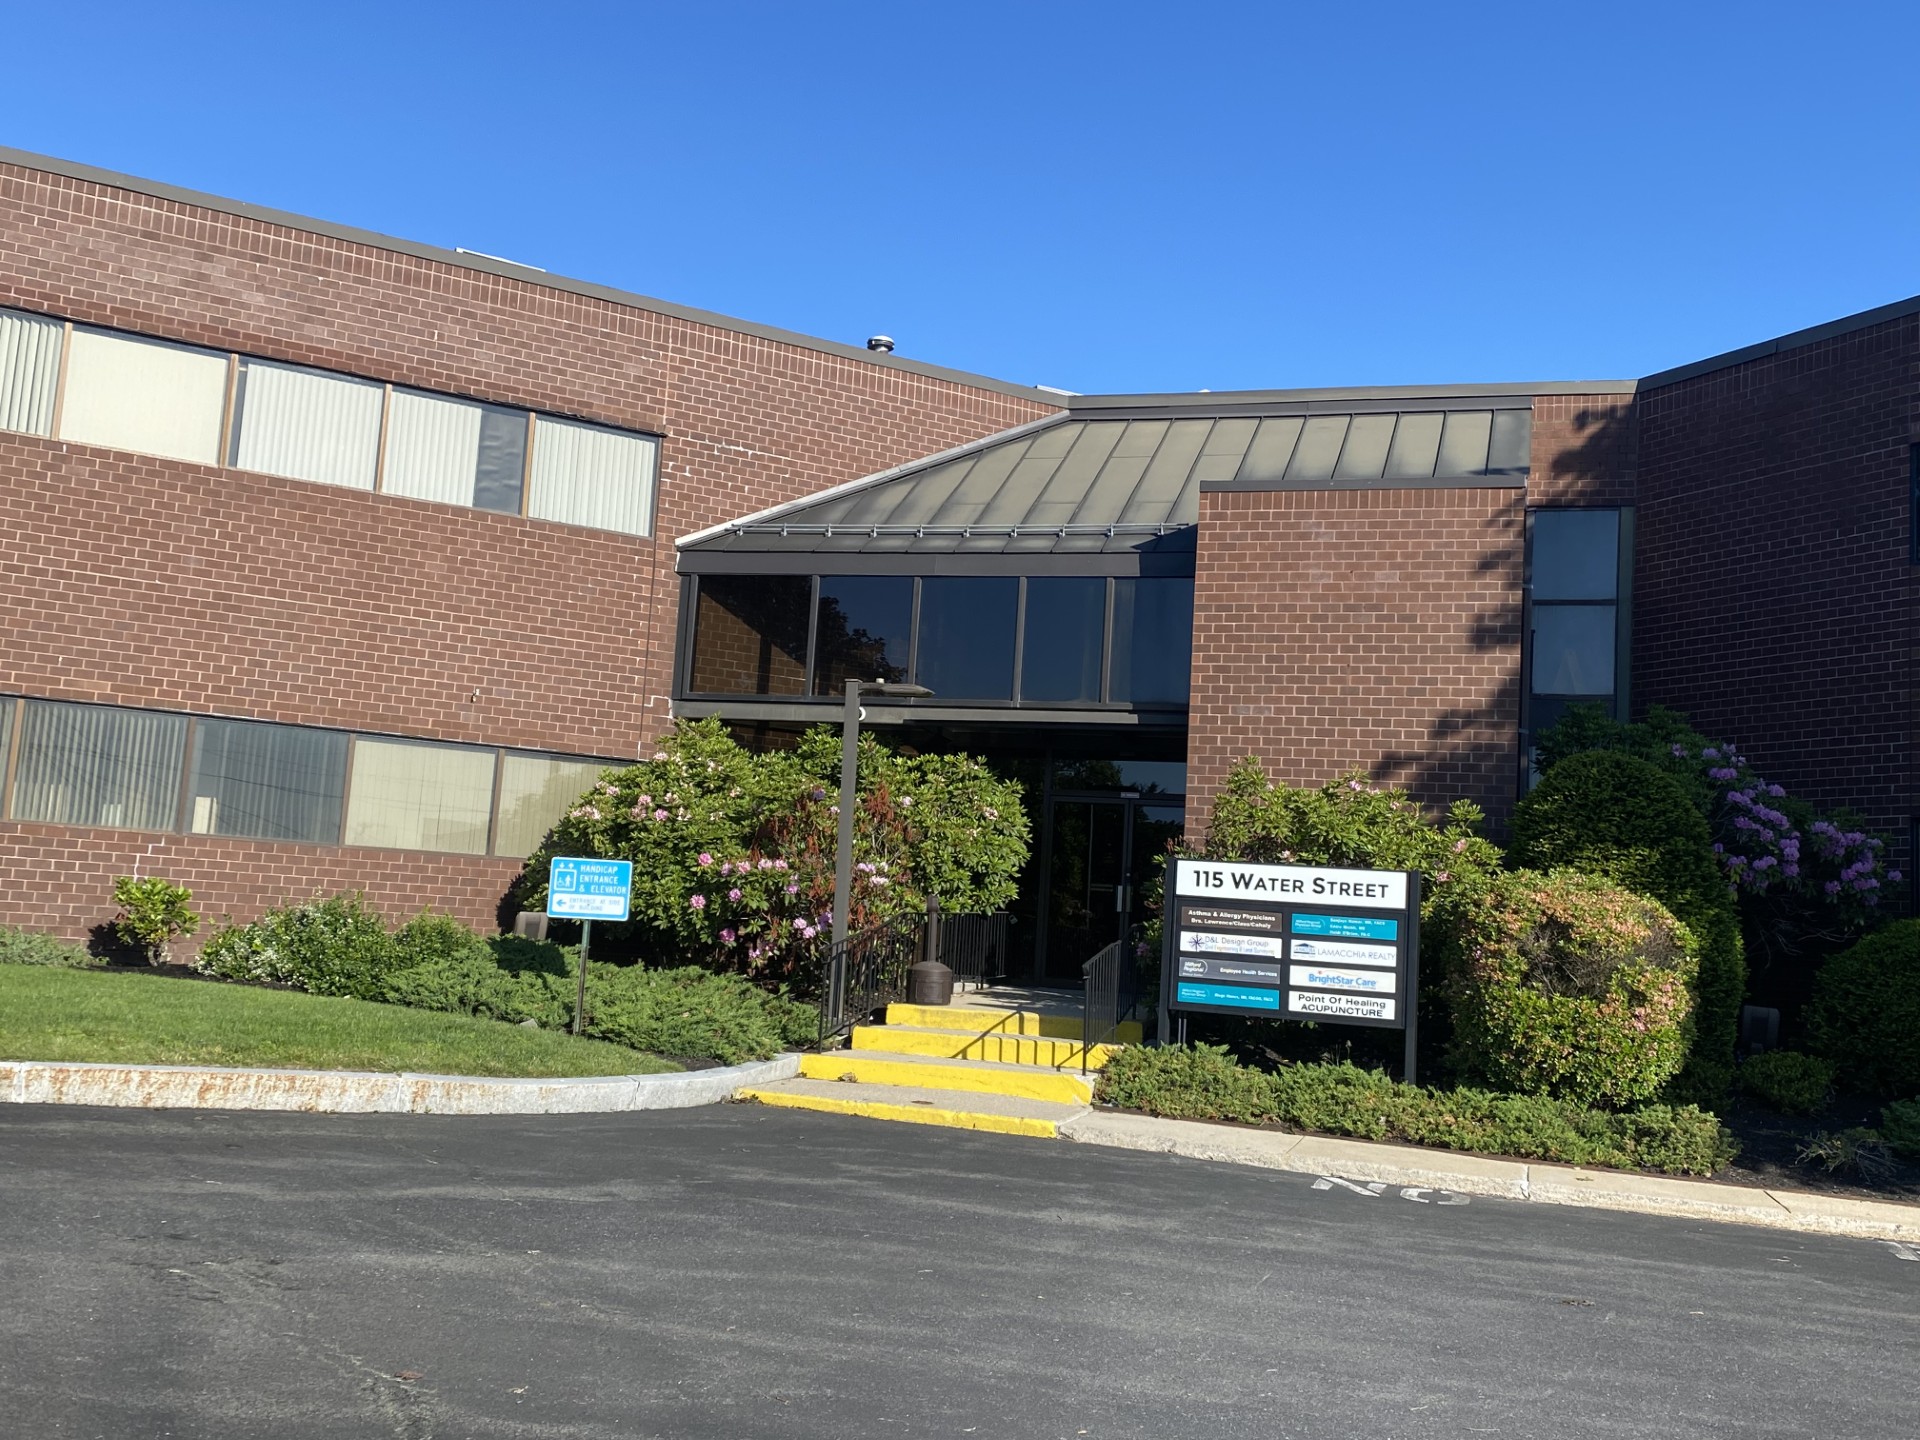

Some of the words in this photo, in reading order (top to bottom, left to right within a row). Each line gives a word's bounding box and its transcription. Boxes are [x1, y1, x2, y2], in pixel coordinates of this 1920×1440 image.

[581, 865, 618, 874] HANDICAP
[580, 874, 618, 884] ENTRANCE
[1193, 870, 1224, 888] 115
[590, 886, 626, 894] ELEVATOR
[1221, 937, 1245, 946] Design
[1247, 939, 1268, 947] Group
[1318, 948, 1365, 958] LAMACCHIA
[1368, 952, 1395, 960] REALTY
[1309, 974, 1353, 985] BrightStar
[1356, 978, 1376, 986] Care
[1298, 994, 1325, 1003] Point
[1346, 998, 1386, 1009] Healing
[1301, 1004, 1383, 1017] ACUPUNCTURE
[1310, 1176, 1470, 1206] NO
